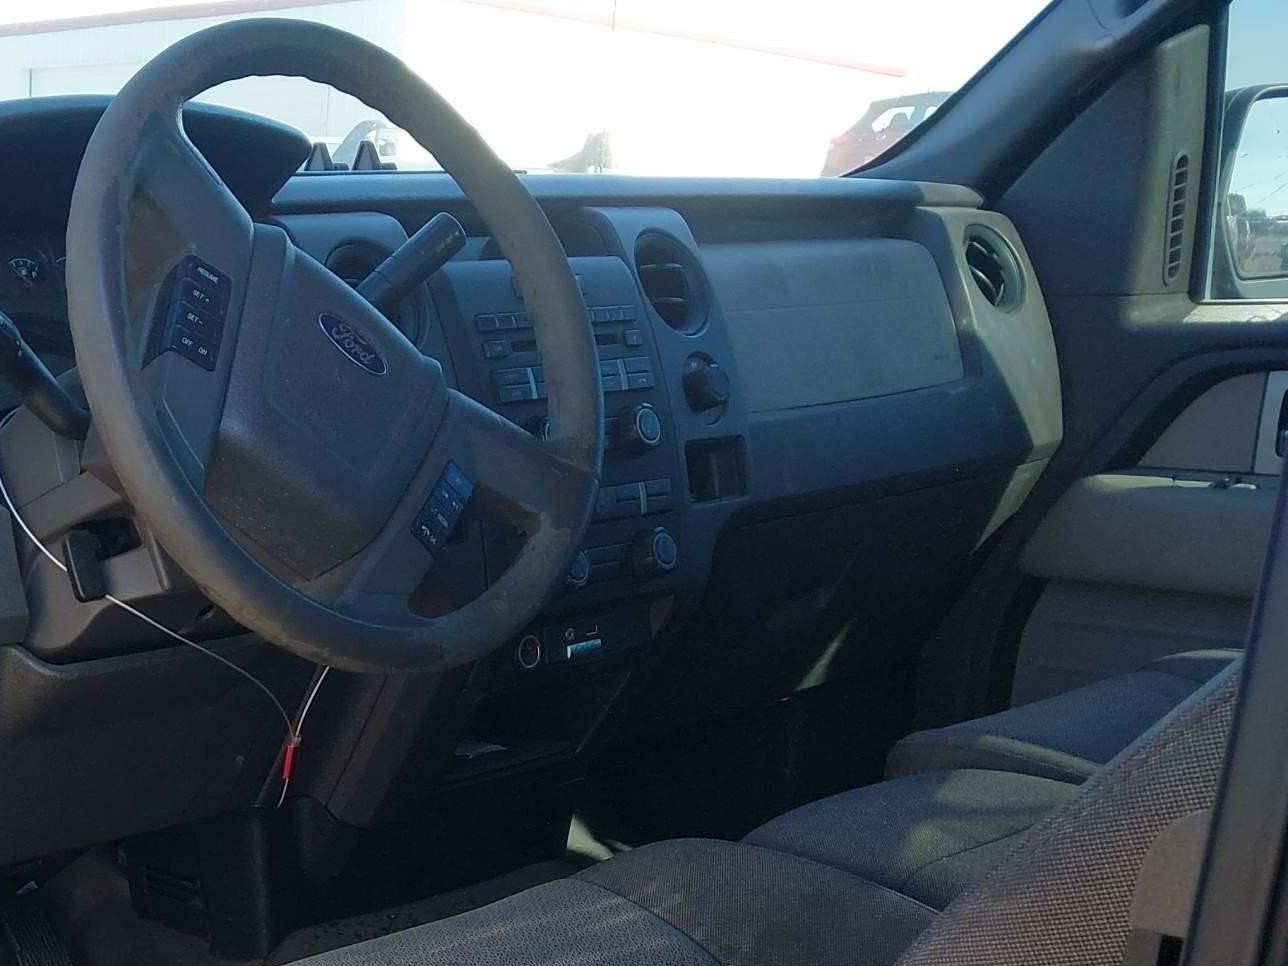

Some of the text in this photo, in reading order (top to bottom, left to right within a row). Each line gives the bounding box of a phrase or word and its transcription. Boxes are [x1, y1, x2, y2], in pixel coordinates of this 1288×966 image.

[192, 289, 205, 300] SET
[187, 312, 199, 323] SET
[331, 323, 375, 364] Ford
